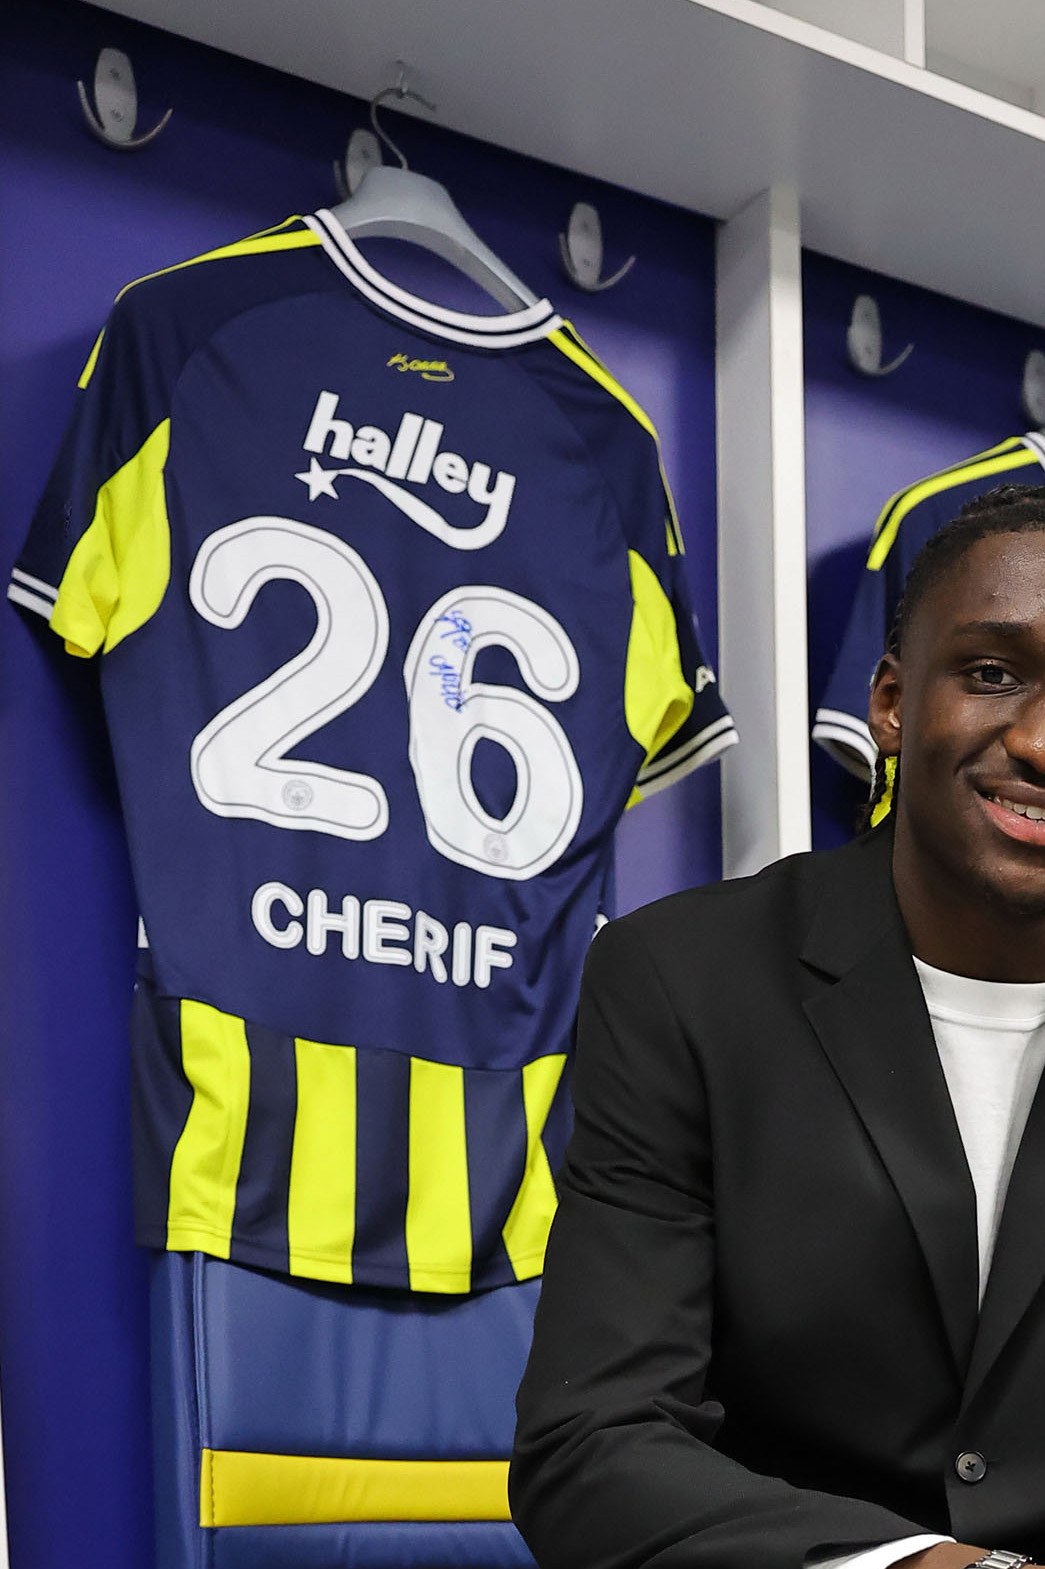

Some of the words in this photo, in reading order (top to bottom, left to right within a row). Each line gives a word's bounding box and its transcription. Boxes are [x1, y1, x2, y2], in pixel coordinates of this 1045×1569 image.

[302, 389, 517, 551] halley
[188, 515, 584, 881] 26
[251, 880, 518, 989] CHERIF
